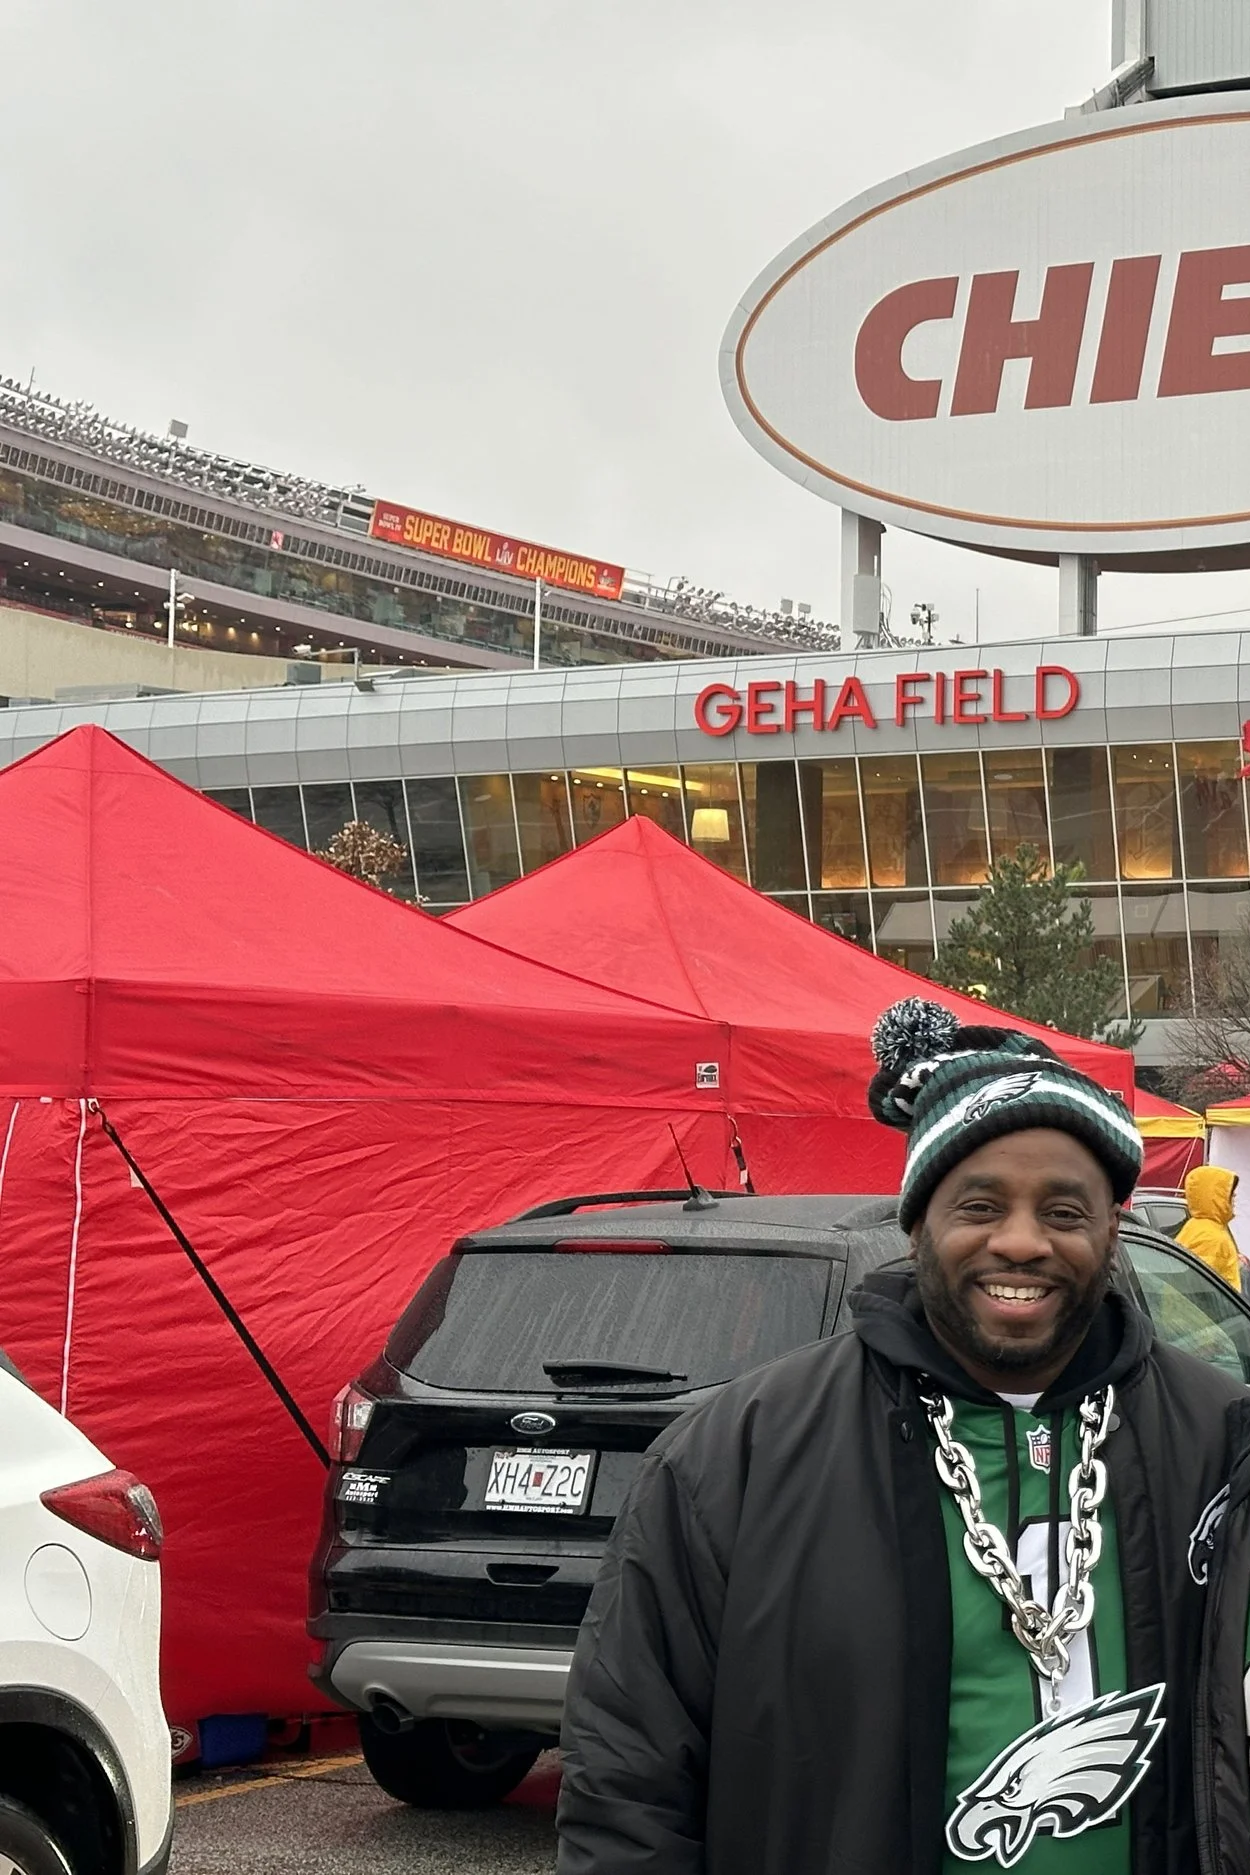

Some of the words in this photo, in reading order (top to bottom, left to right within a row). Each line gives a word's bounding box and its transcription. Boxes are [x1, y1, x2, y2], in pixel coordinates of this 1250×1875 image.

[404, 515, 450, 551] SUPER
[452, 529, 491, 562] BOWL
[516, 546, 596, 588] CHAMPIONS
[695, 676, 877, 736] GEHA
[895, 666, 1080, 727] FIELD
[533, 1448, 570, 1456] AUTOSPORT
[487, 1462, 533, 1496] XH4
